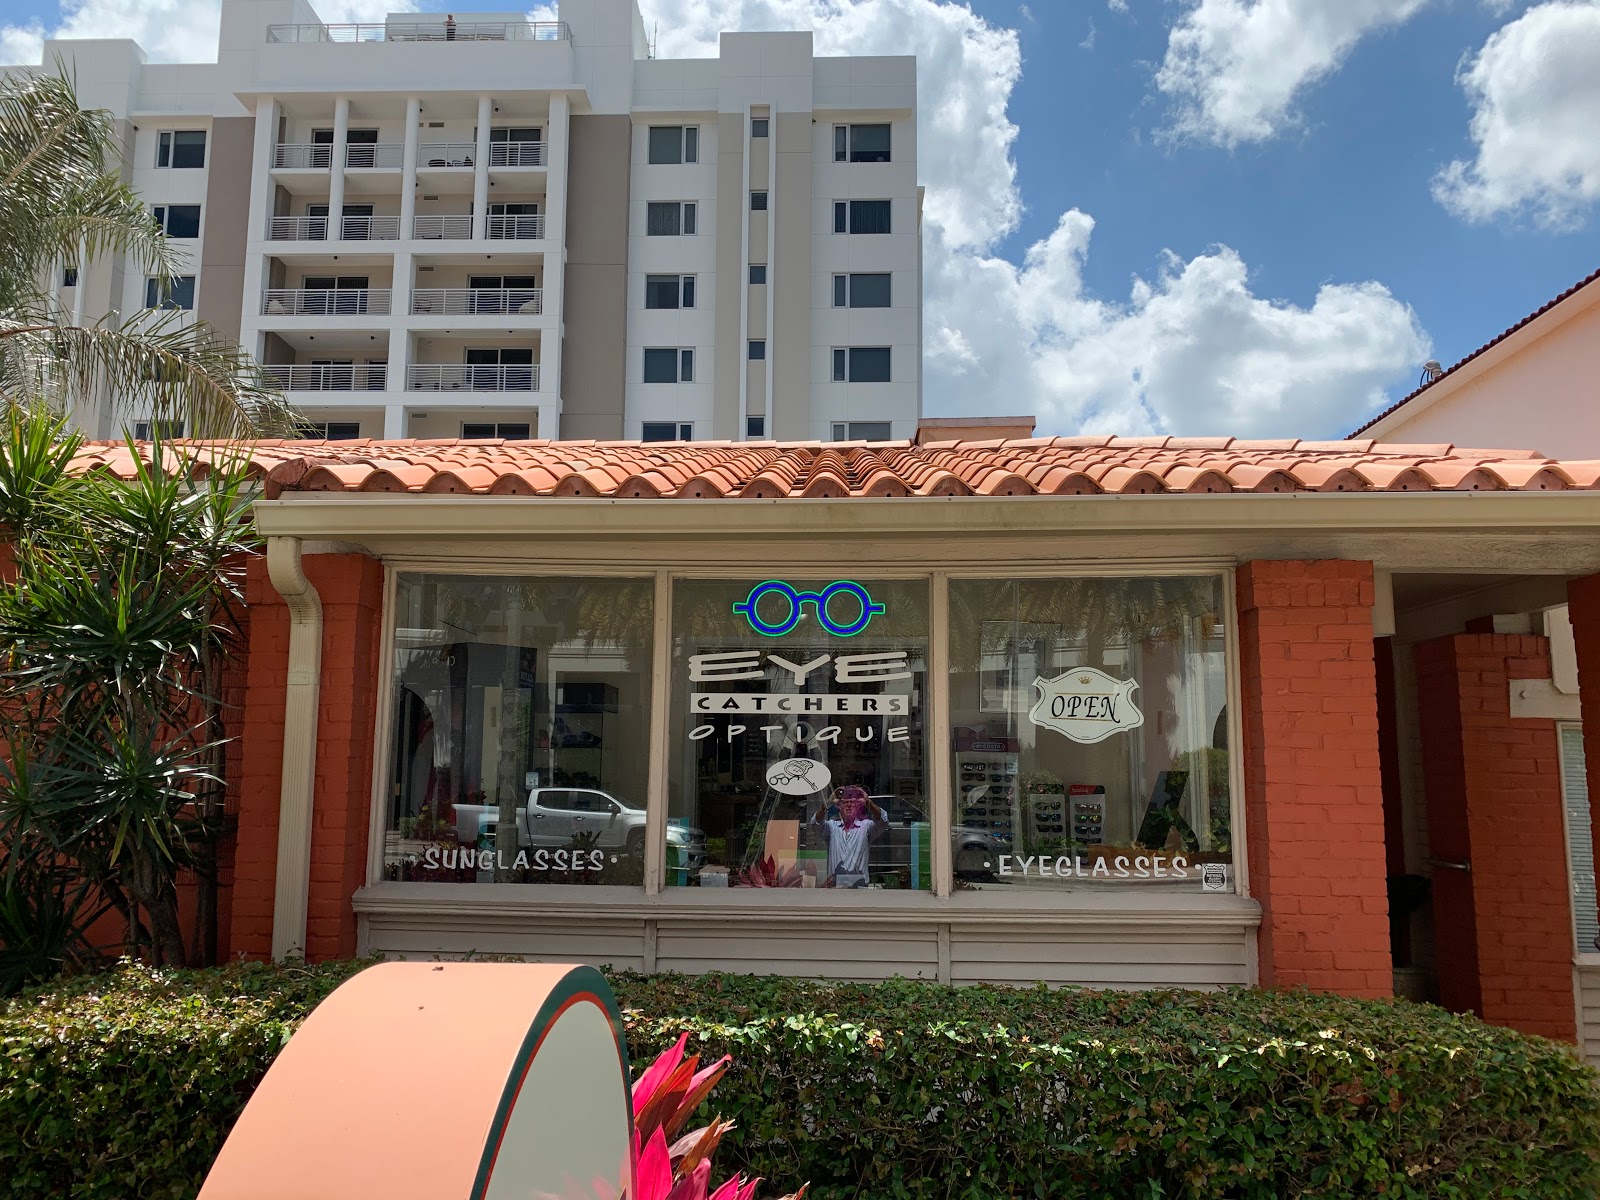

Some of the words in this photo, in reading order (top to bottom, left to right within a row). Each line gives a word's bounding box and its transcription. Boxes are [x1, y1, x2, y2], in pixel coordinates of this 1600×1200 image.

[688, 650, 911, 686] EYE
[697, 696, 901, 712] CATCHERS
[1051, 692, 1121, 724] OPEN
[688, 724, 910, 744] OPTIQUE
[423, 848, 604, 871] SUNGLASSES
[999, 855, 1188, 878] EYEGLASSES
